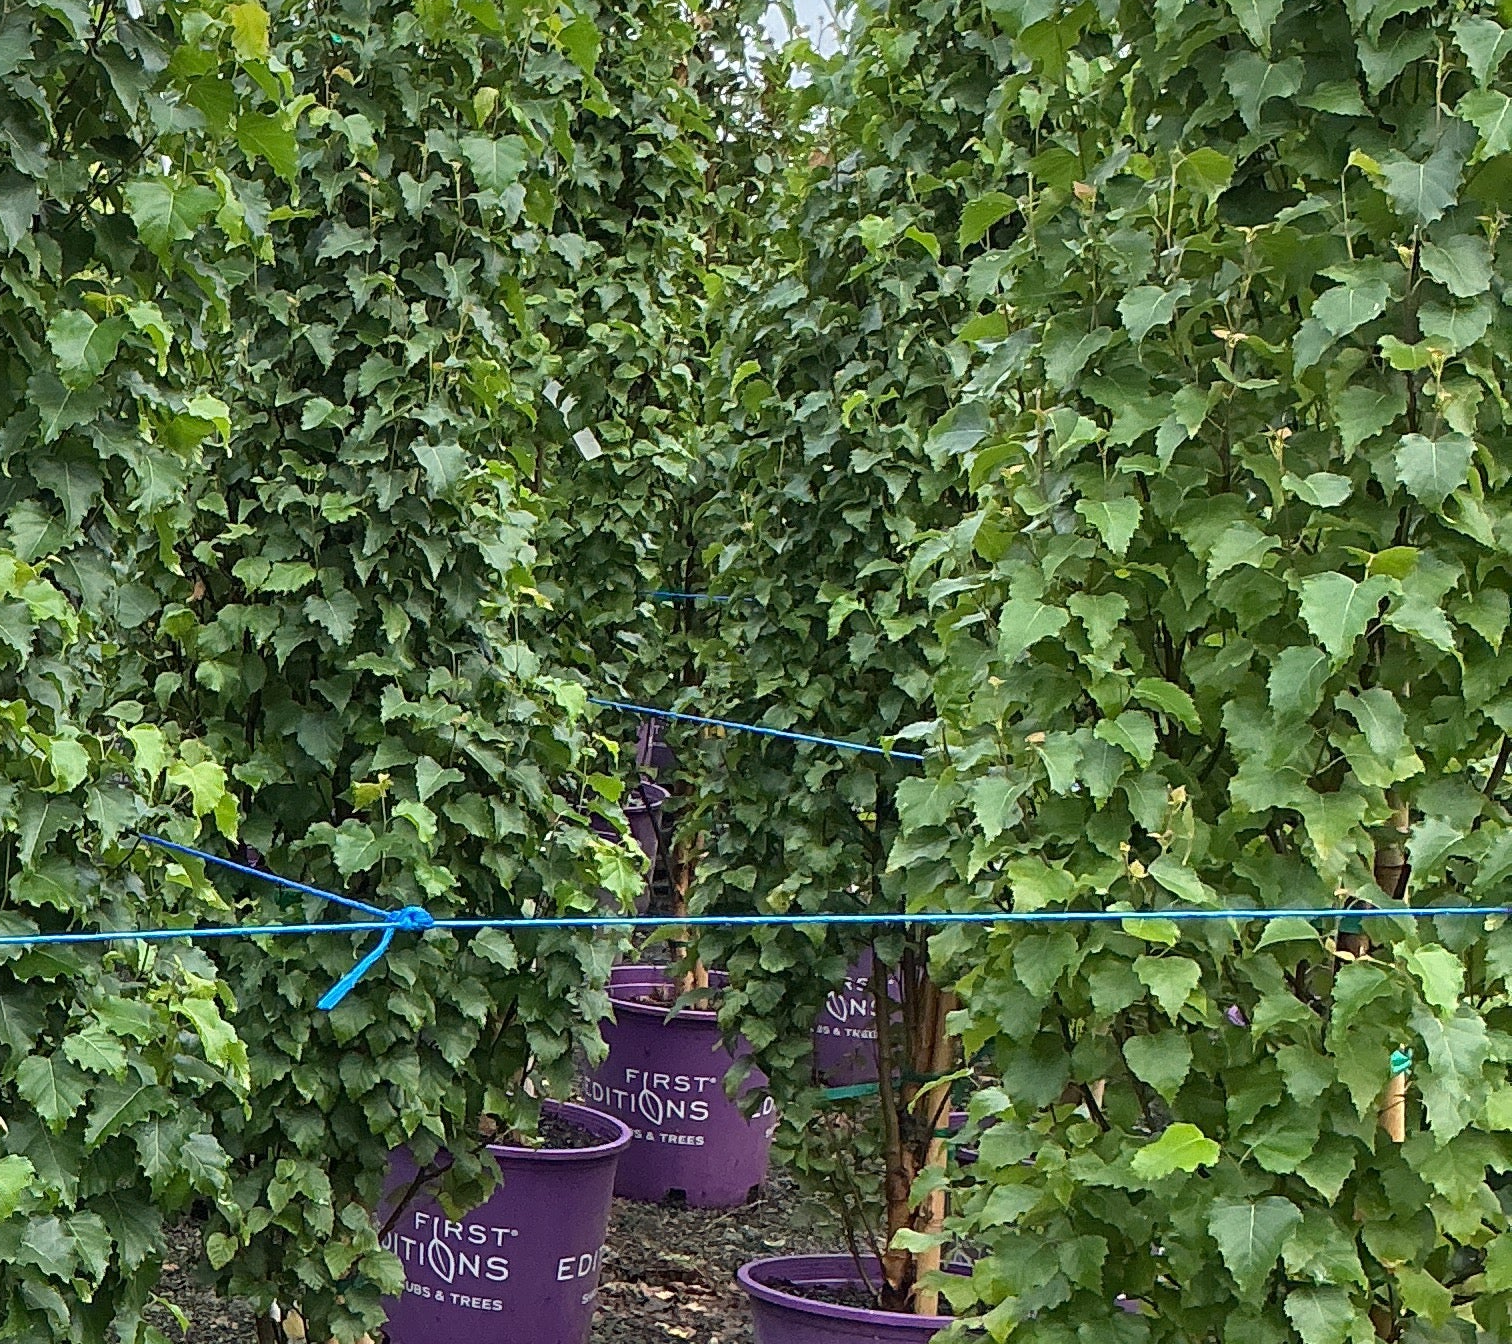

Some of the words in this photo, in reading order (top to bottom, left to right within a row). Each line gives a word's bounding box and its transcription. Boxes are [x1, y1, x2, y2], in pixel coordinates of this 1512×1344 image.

[659, 1132, 705, 1146] TREES
[434, 1290, 445, 1302] &
[450, 1293, 504, 1312] TREES
